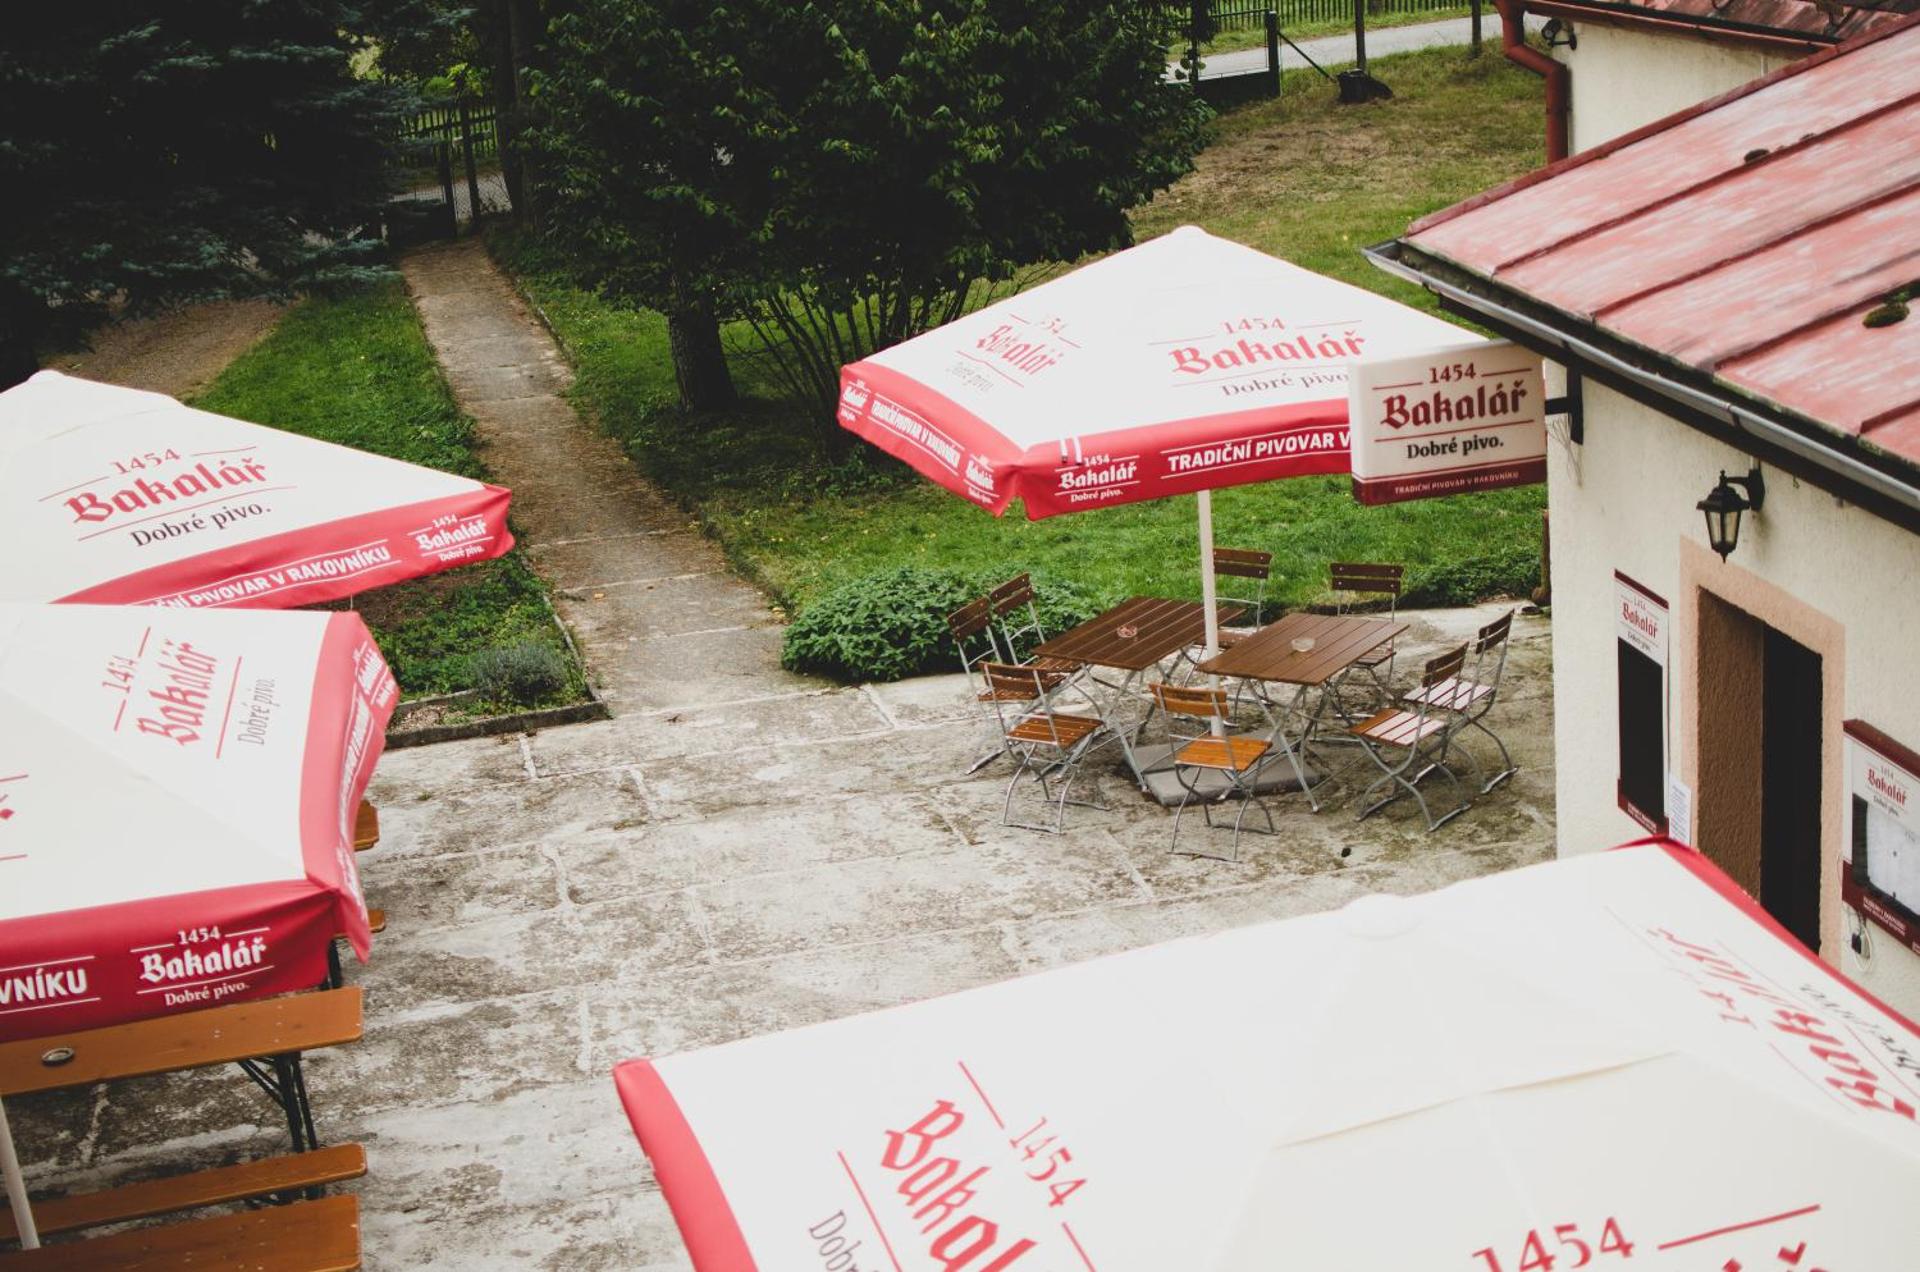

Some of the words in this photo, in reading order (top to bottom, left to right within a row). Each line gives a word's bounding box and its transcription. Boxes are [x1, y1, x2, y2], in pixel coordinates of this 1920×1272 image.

[1224, 318, 1285, 334] 1454
[1169, 330, 1365, 374] Bakalář
[1222, 373, 1294, 395] Dobré
[1429, 362, 1476, 383] 1454
[1380, 379, 1527, 429] Bakalář
[111, 448, 180, 474] 1454
[1084, 454, 1110, 467] 1454
[1168, 440, 1252, 471] TRADIČNÍ
[1256, 432, 1334, 456] PIVOVAR
[1339, 431, 1351, 448] V
[1407, 437, 1458, 459] Dobré
[1462, 434, 1504, 456] pivo.
[1058, 461, 1137, 489] Bakalář
[1394, 482, 1431, 495] TRADIČNÍ
[1431, 479, 1465, 489] PIVOVAR
[64, 457, 267, 523] Bakalář
[1071, 491, 1099, 502] Dobré
[130, 513, 205, 546] Dobré
[211, 503, 272, 529] pivo.
[415, 519, 487, 550] Bakalář
[189, 576, 271, 606] PIVOVAR
[269, 572, 285, 586] V
[286, 545, 391, 581] RAKOVNÍKU
[137, 639, 218, 746] Bakalář
[237, 701, 272, 746] Dobré
[178, 926, 220, 945] 1454
[140, 936, 267, 982] Bakalář
[165, 986, 209, 1006] Dobré
[213, 981, 249, 999] pivo.
[1009, 1116, 1087, 1207] 1454
